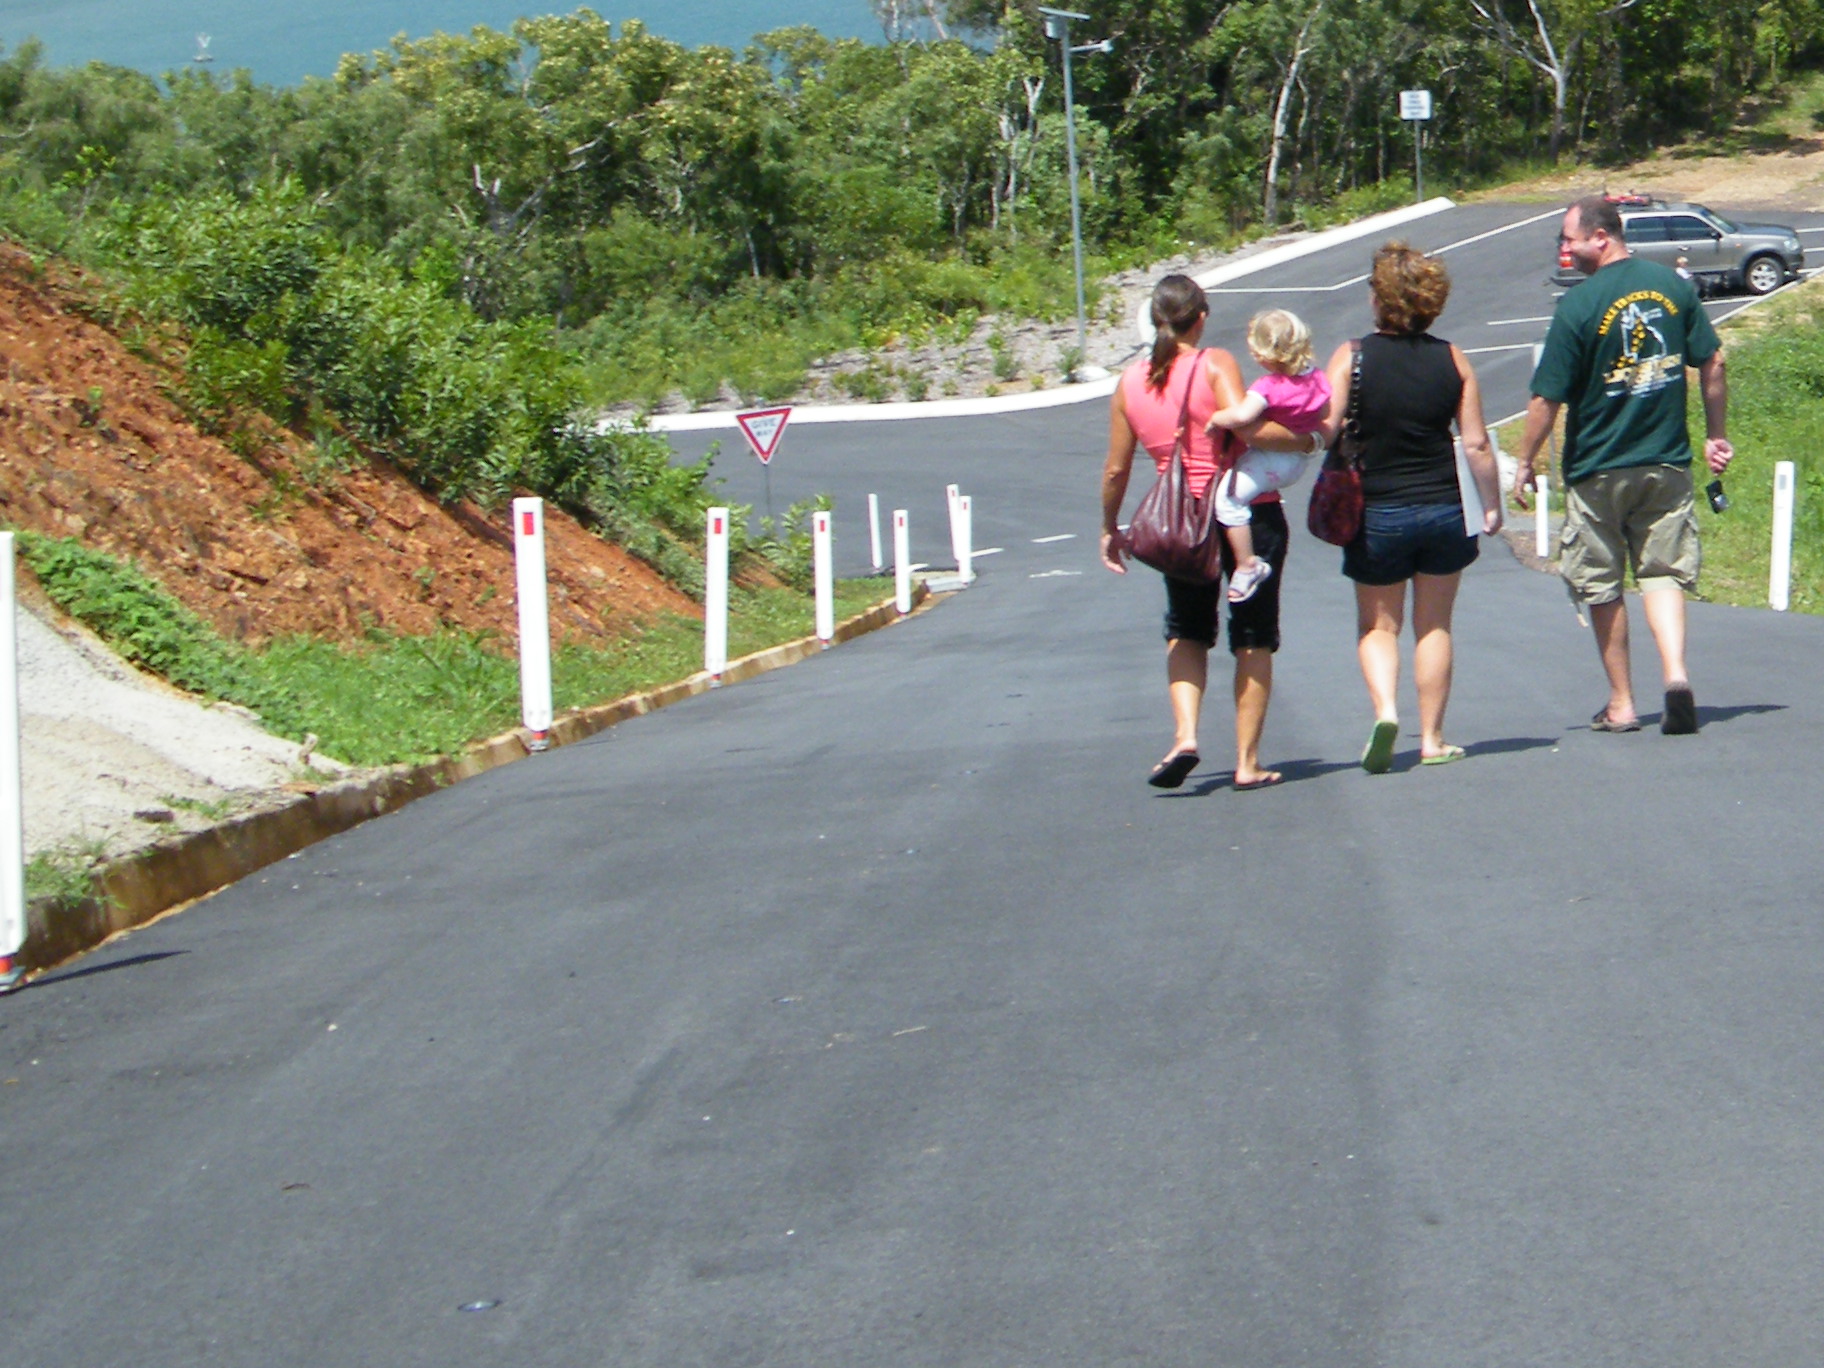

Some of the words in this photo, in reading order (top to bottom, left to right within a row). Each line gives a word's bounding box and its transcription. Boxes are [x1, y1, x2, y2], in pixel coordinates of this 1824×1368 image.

[1598, 307, 1619, 336] MAKE
[1613, 290, 1650, 310] TRACKS
[1650, 290, 1665, 303] TO
[751, 417, 776, 429] GIVE
